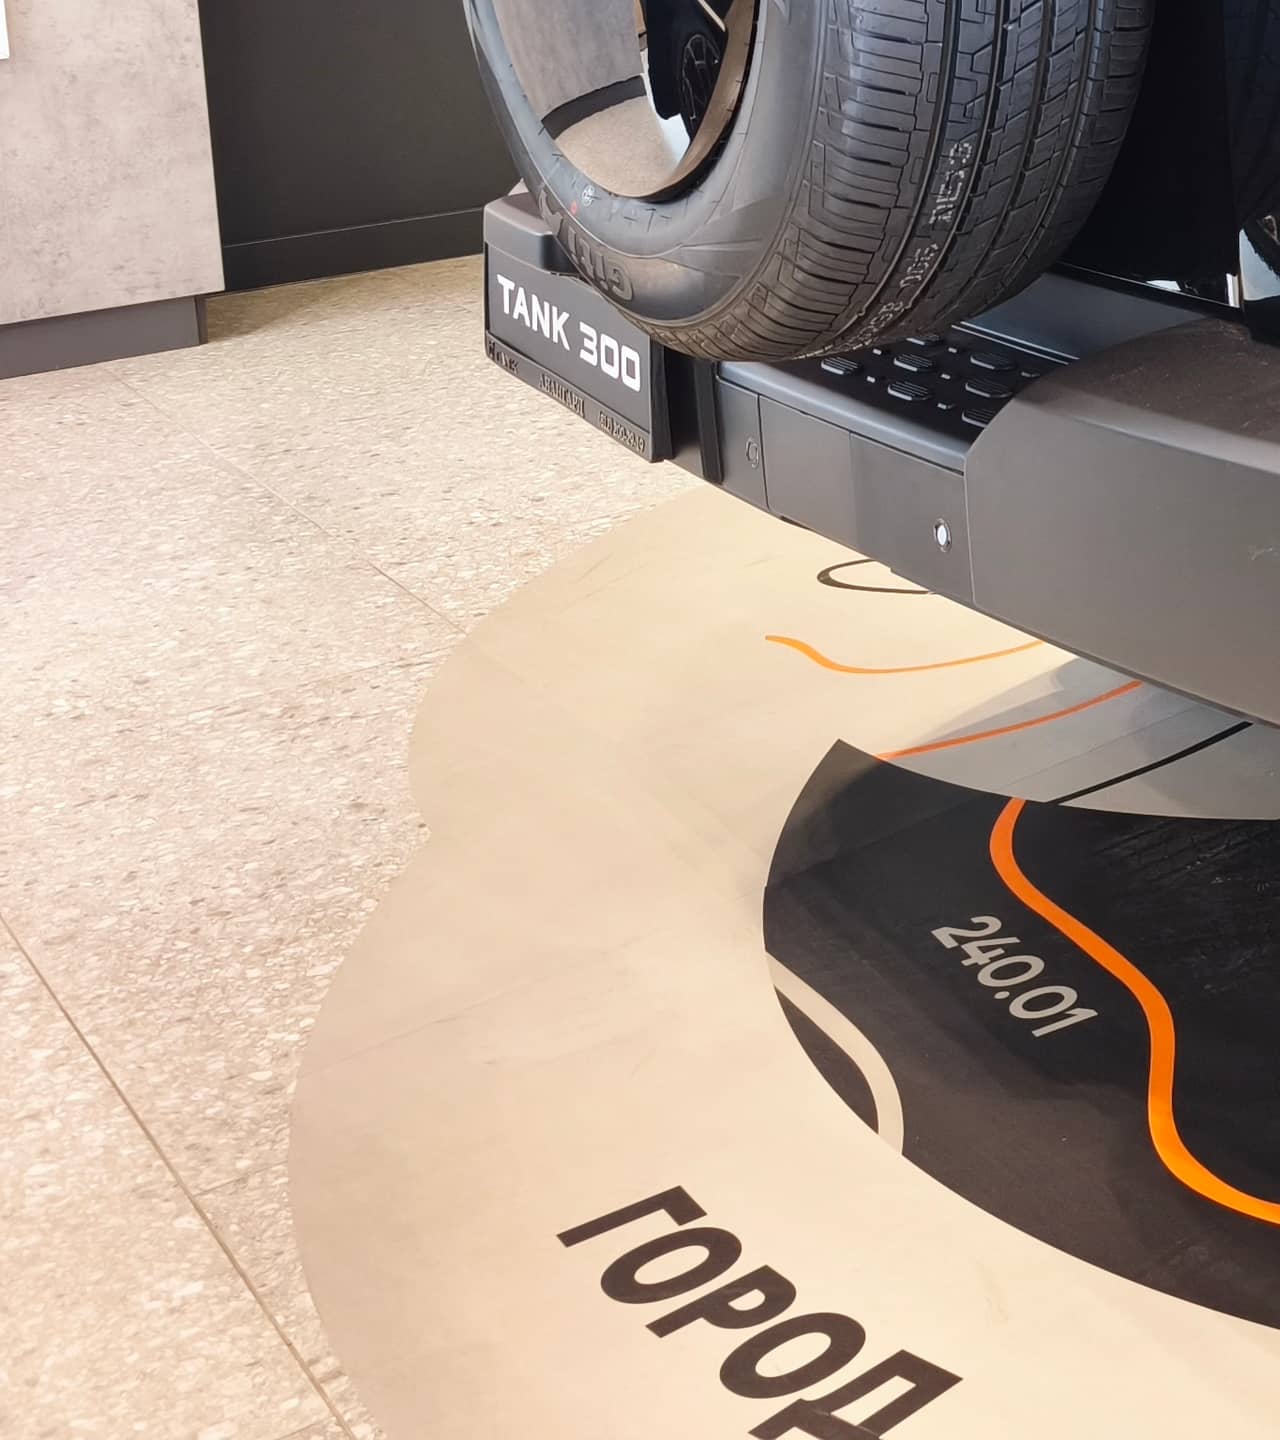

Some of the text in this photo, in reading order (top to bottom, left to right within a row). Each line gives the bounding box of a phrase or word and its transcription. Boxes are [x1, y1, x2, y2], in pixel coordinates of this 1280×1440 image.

[496, 274, 641, 392] TANK 300
[931, 915, 1098, 1037] 240.01
[556, 1185, 963, 1439] ГОРОД
